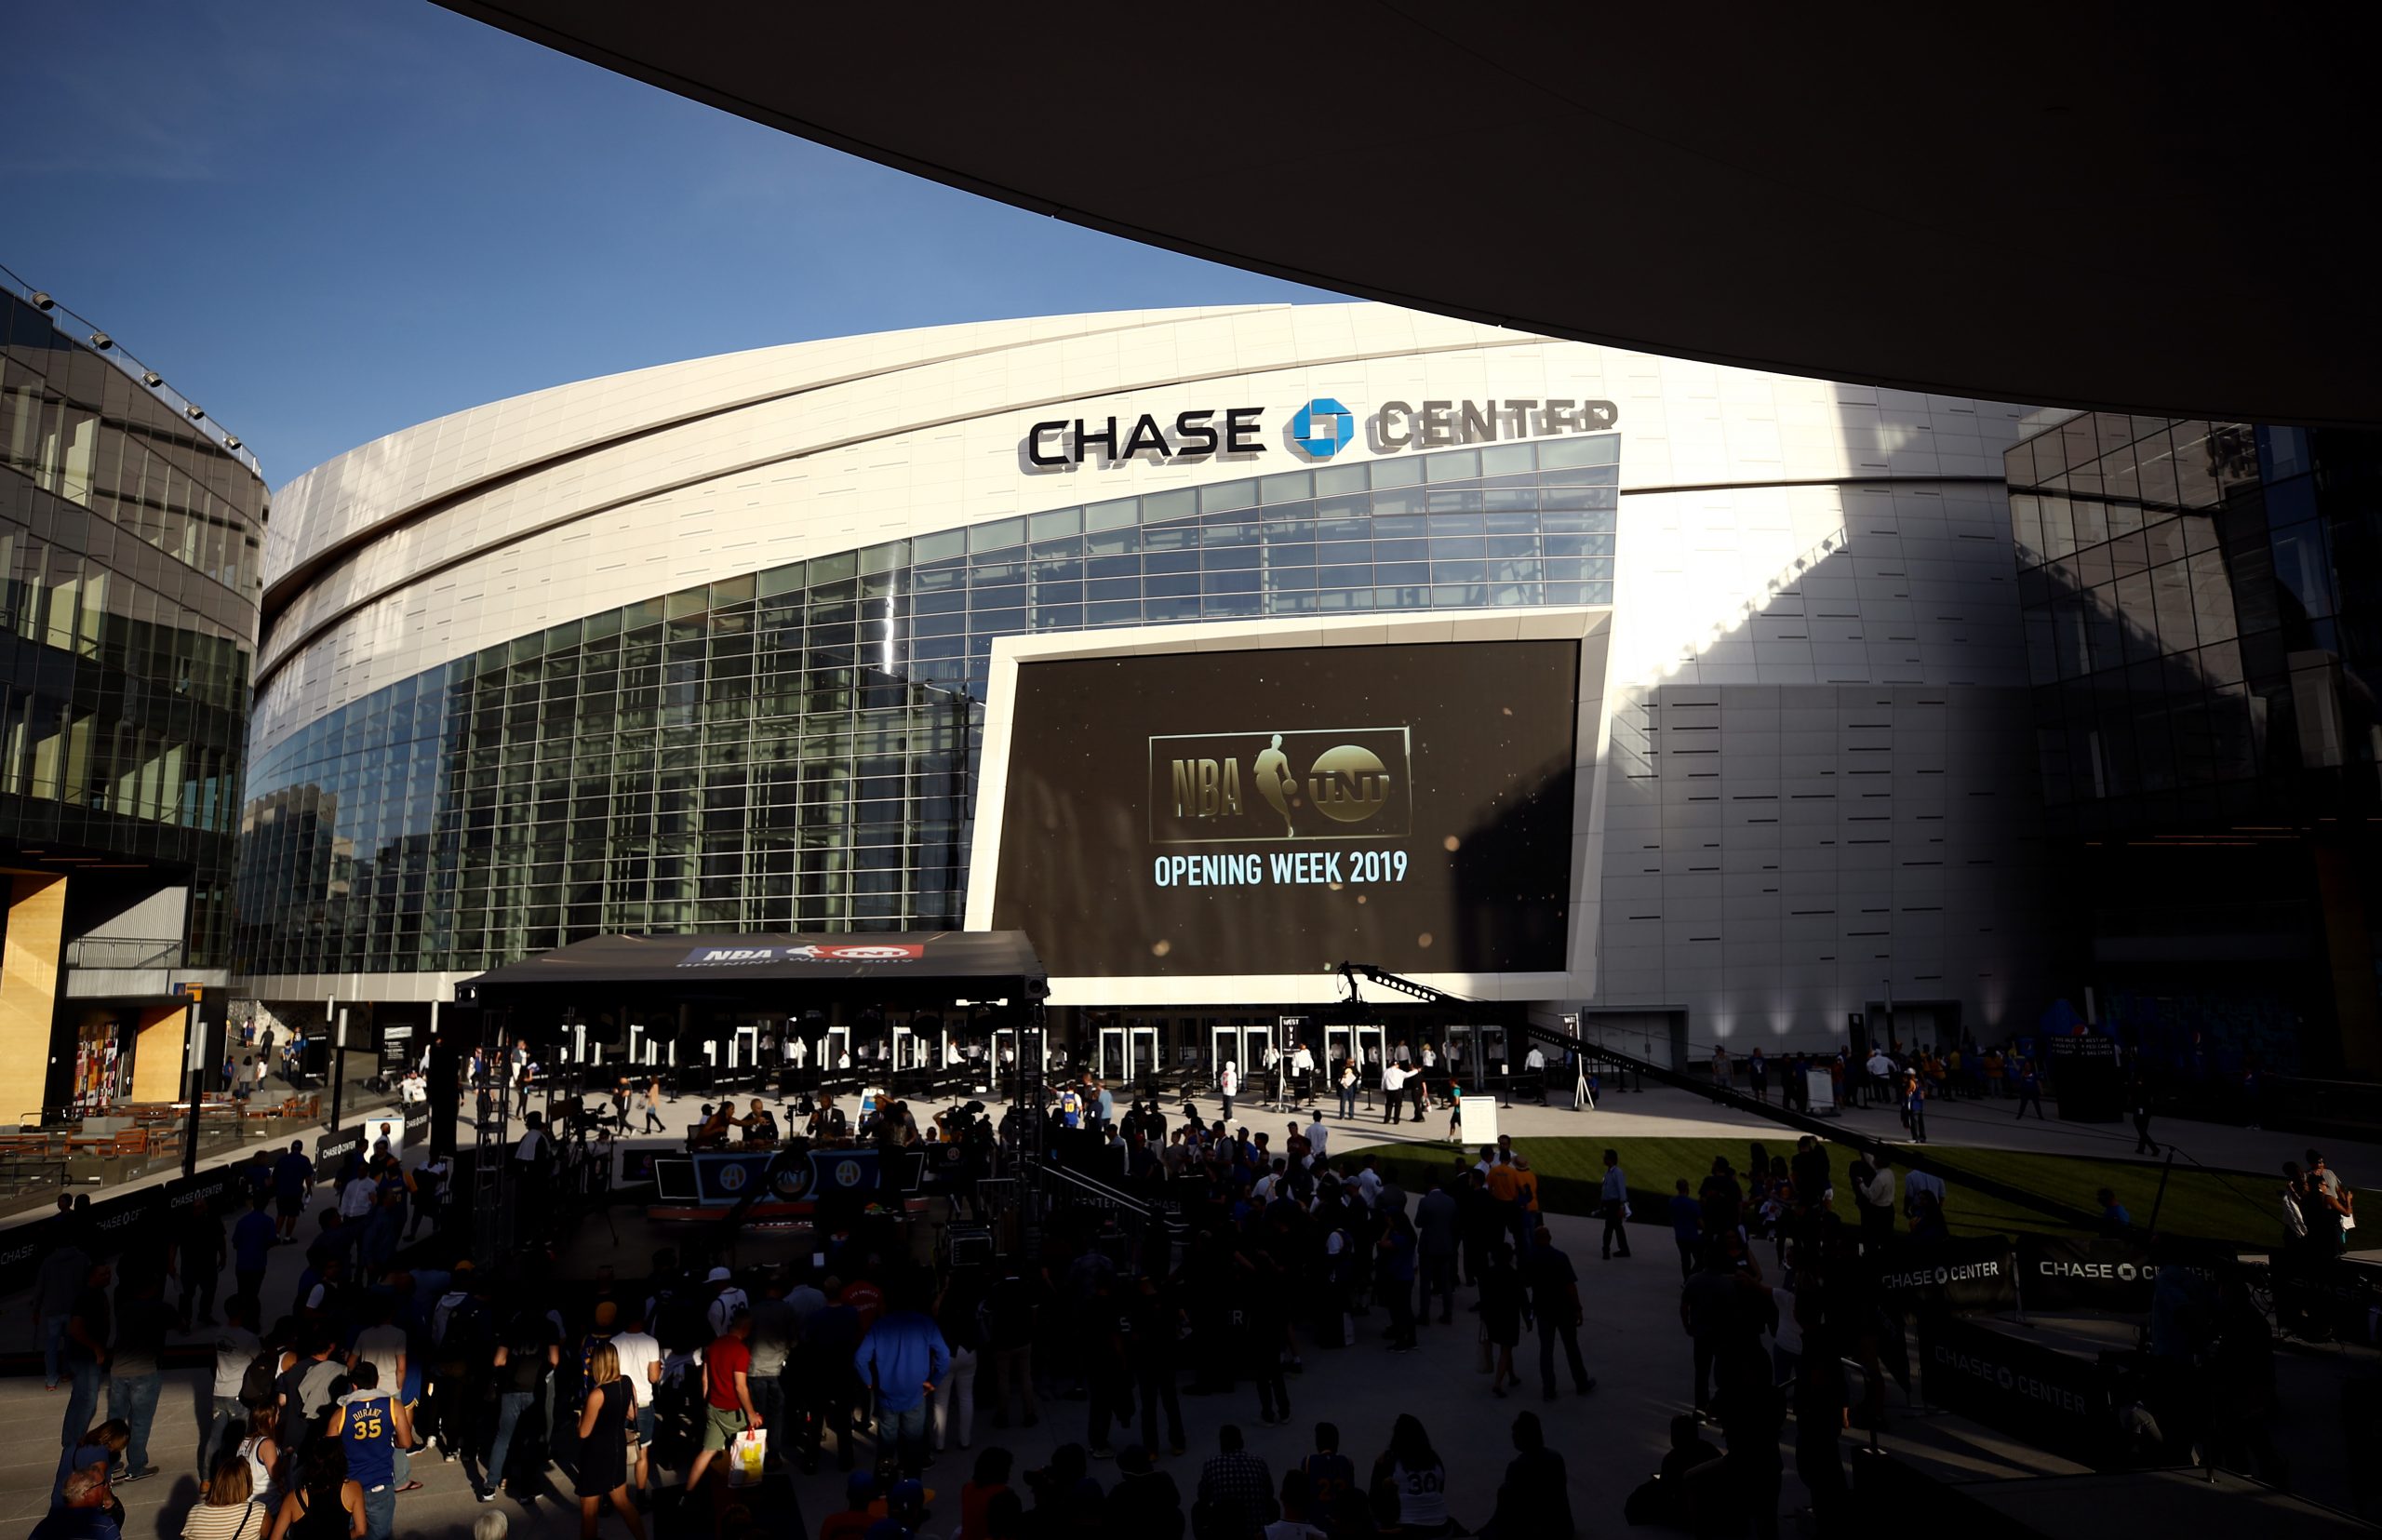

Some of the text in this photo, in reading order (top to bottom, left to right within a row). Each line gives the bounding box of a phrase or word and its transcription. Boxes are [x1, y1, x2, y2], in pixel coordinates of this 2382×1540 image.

[1028, 399, 1618, 465] CHASE CENTER
[1171, 757, 1389, 817] NBA TNT
[1154, 850, 1408, 887] OPENING WEEK 2019
[676, 959, 780, 968] OPENING
[703, 948, 909, 961] NBA TNT
[322, 1140, 356, 1159] CHASE CENTER
[170, 1194, 194, 1209] CHASE
[201, 1183, 223, 1199] CENTER
[0, 1244, 34, 1265] CHASE
[1881, 1261, 2000, 1290] CHASE CENTER
[2039, 1261, 2114, 1279] CHASE
[1935, 1345, 2087, 1415] CHASE CENTER
[353, 1408, 382, 1421] DURANT
[354, 1418, 382, 1440] 35
[1407, 1472, 1437, 1495] 30
